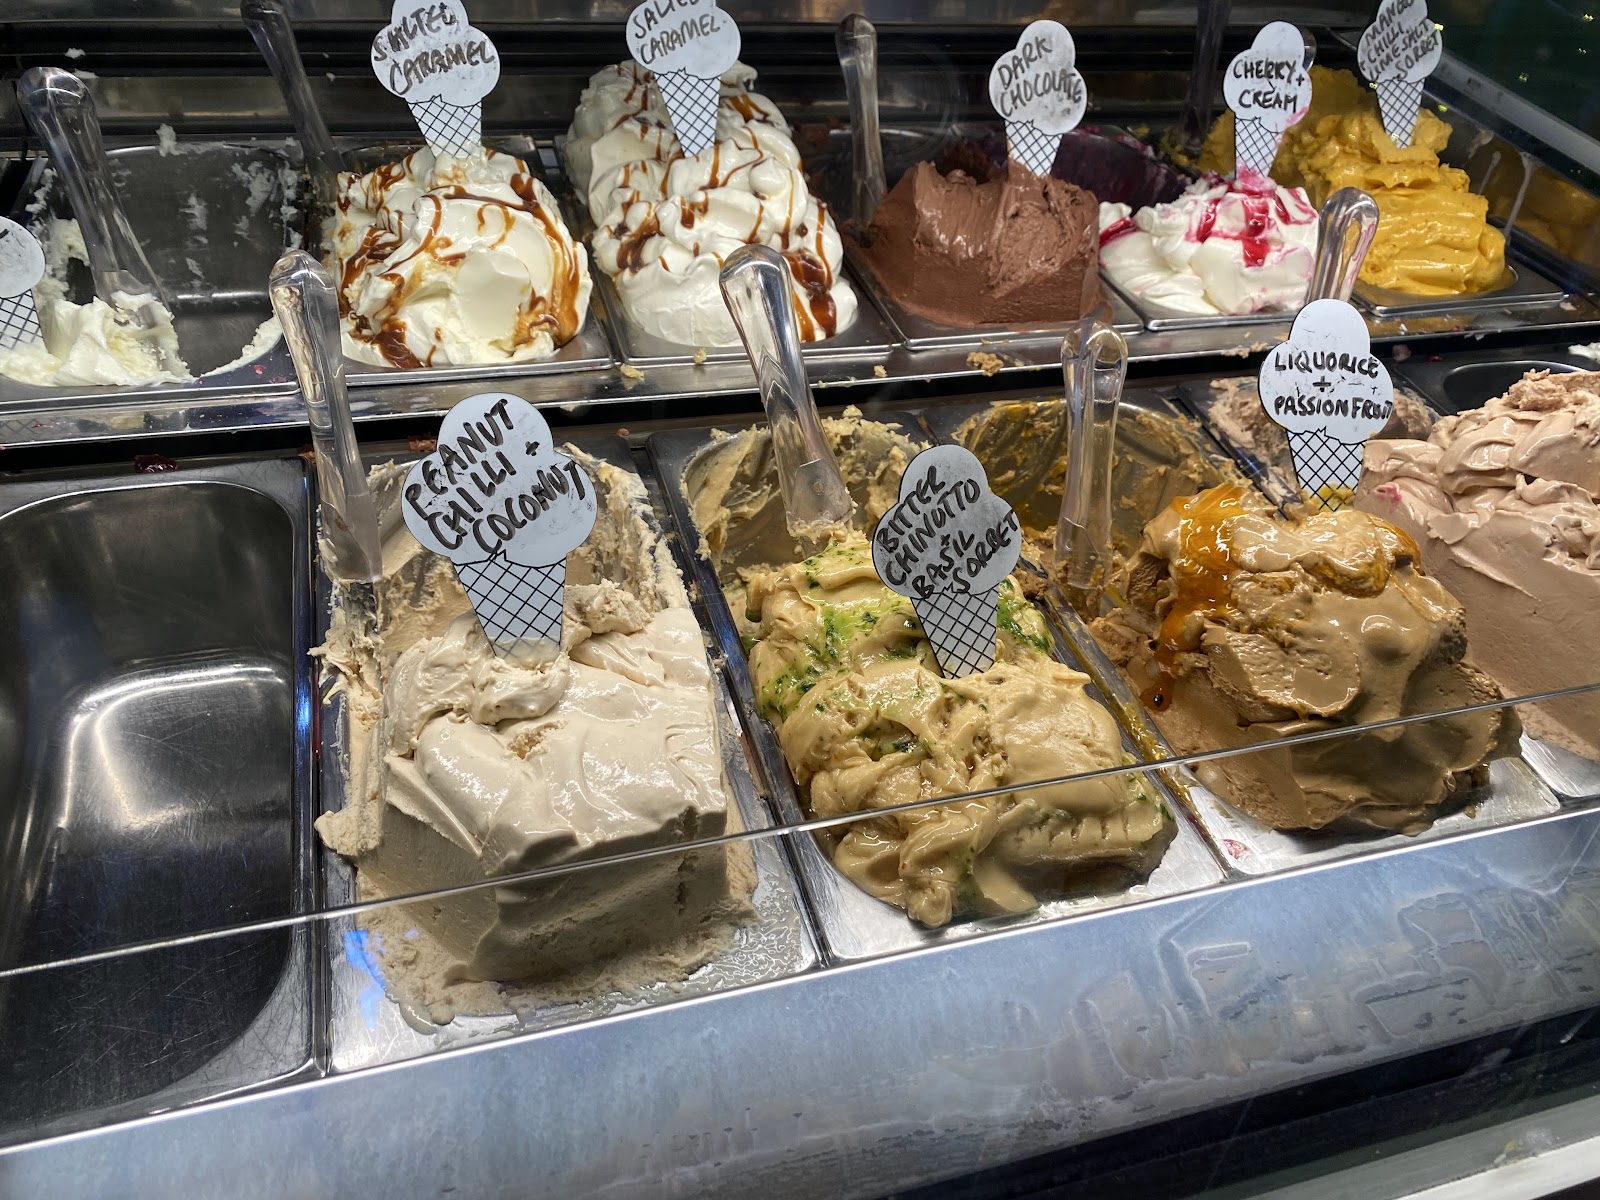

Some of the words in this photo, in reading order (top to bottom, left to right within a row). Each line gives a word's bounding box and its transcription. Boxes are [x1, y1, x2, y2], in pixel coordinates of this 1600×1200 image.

[389, 40, 495, 95] CARAMEL
[640, 13, 721, 65] CARAMEL
[997, 36, 1053, 90] DARK
[1000, 67, 1082, 117] CHOCOLATE
[1233, 57, 1297, 84] CHERRY
[1238, 88, 1298, 114] CREAM
[1274, 350, 1380, 379] LIQUORICE
[404, 398, 514, 521] PEANUT
[427, 450, 517, 550] CHILLI
[472, 460, 586, 554] COCONUT
[876, 465, 946, 553] BITTER
[885, 478, 981, 586] CHINOTTO
[952, 509, 1018, 594] SORBET
[912, 530, 975, 599] BASIL
